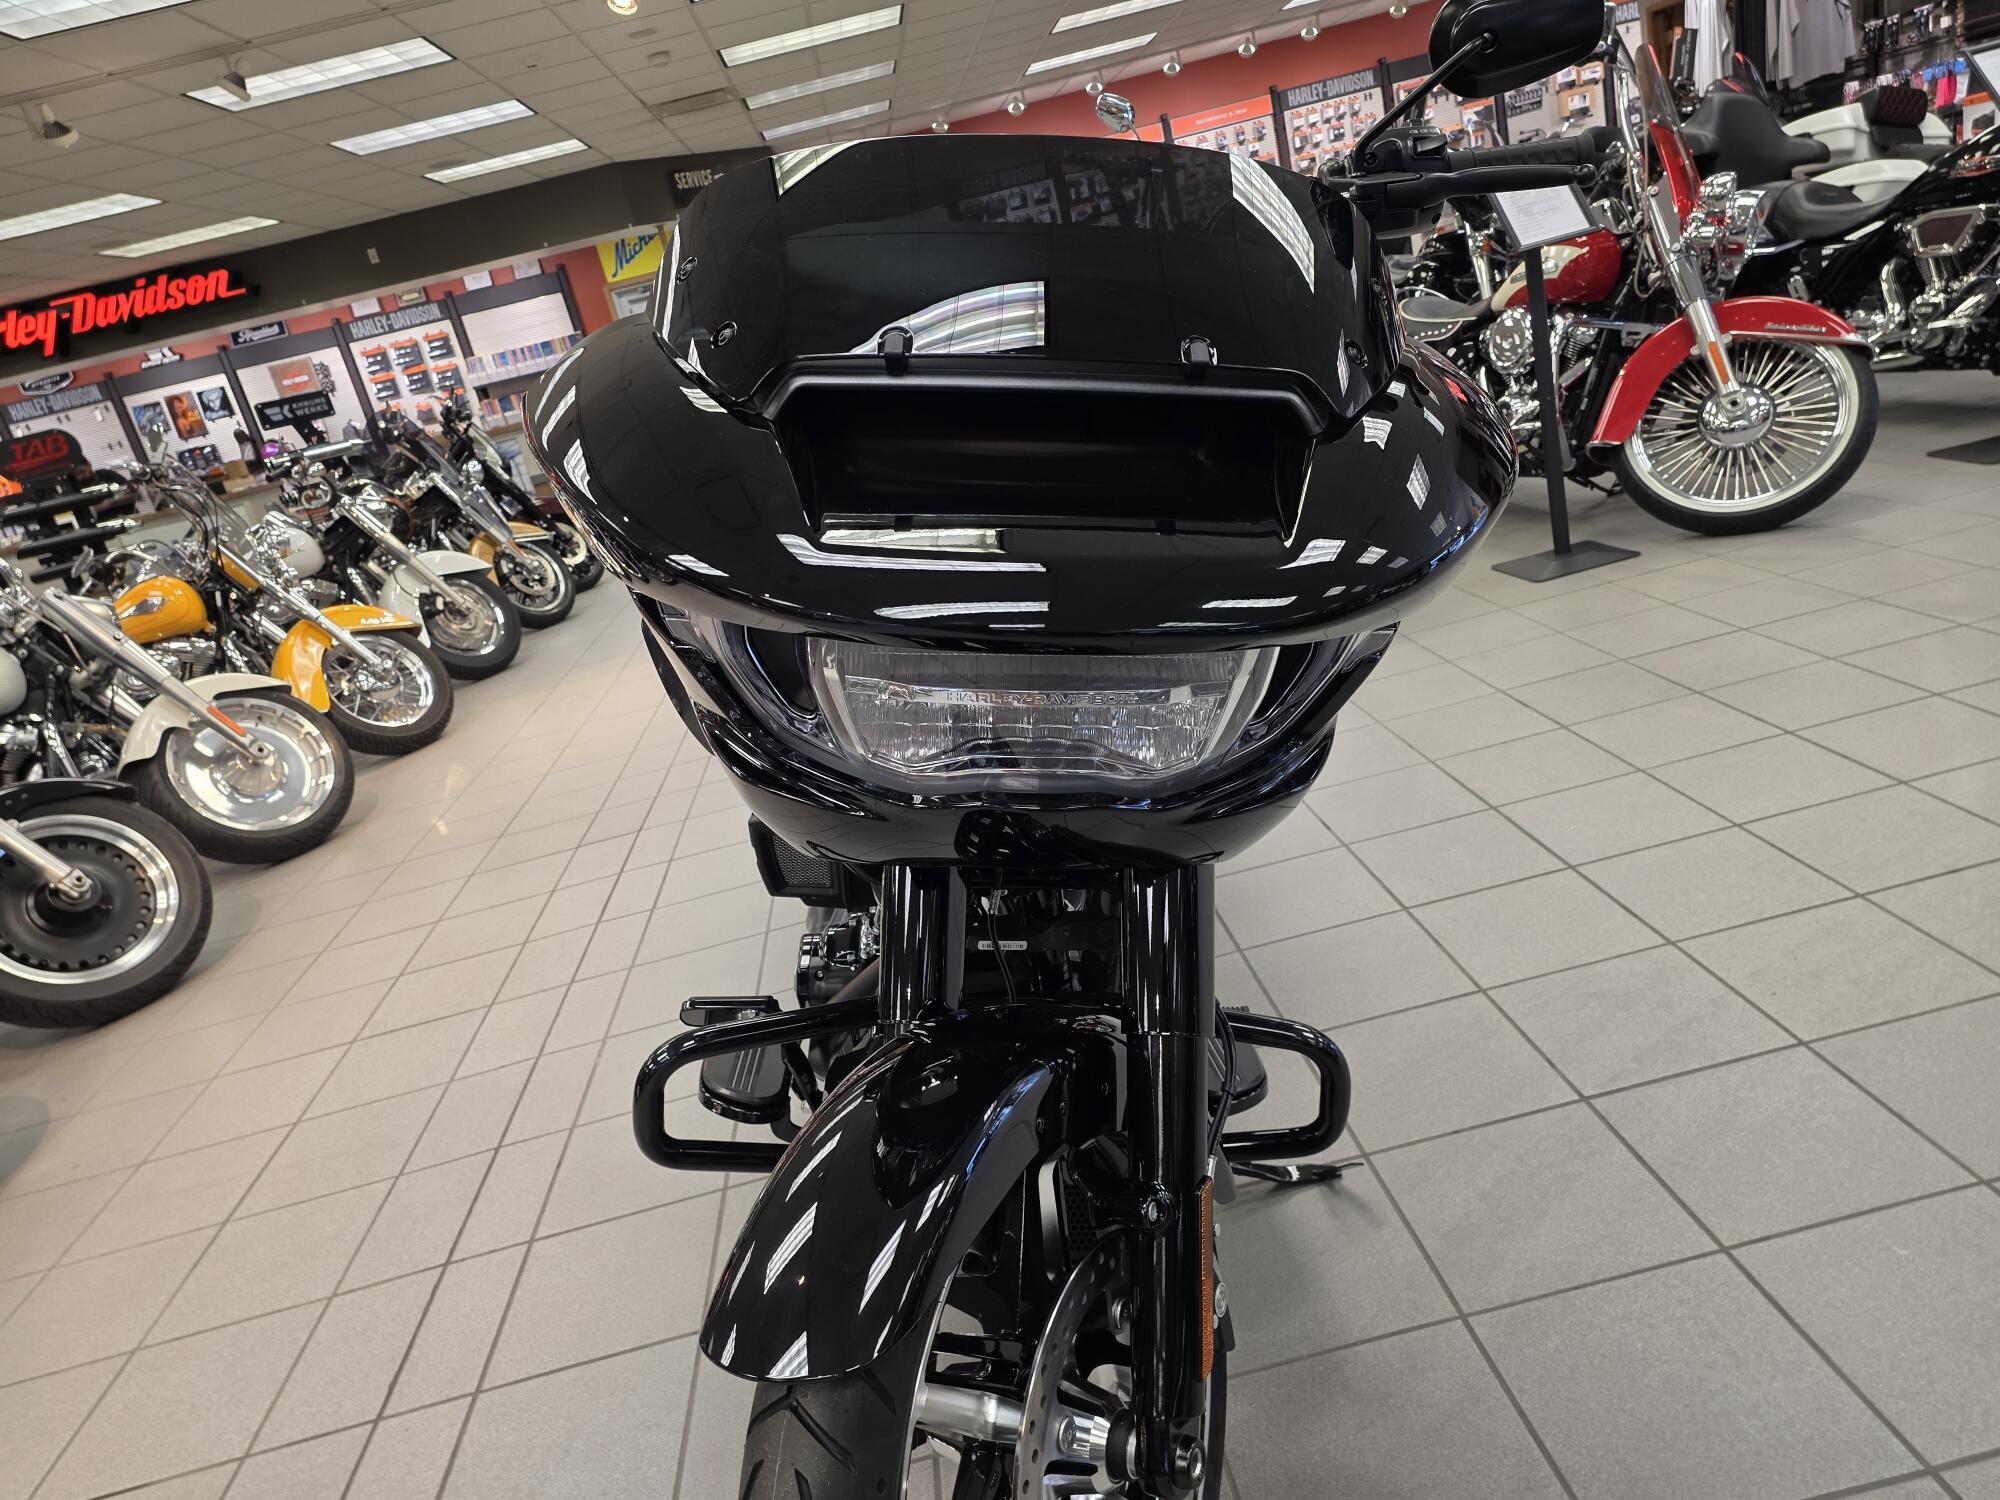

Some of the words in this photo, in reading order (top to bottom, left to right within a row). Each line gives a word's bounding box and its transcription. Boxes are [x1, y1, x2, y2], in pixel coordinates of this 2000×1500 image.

[1287, 69, 1374, 107] HARLEY-DAVIDSON
[674, 169, 712, 189] SERVICE
[349, 303, 441, 339] HARLEY-DAVIDSON
[8, 384, 102, 420] HARLEY-DAVIDSON
[11, 434, 69, 464] TAB
[946, 691, 1137, 705] HARLEY-DAVIDSON
